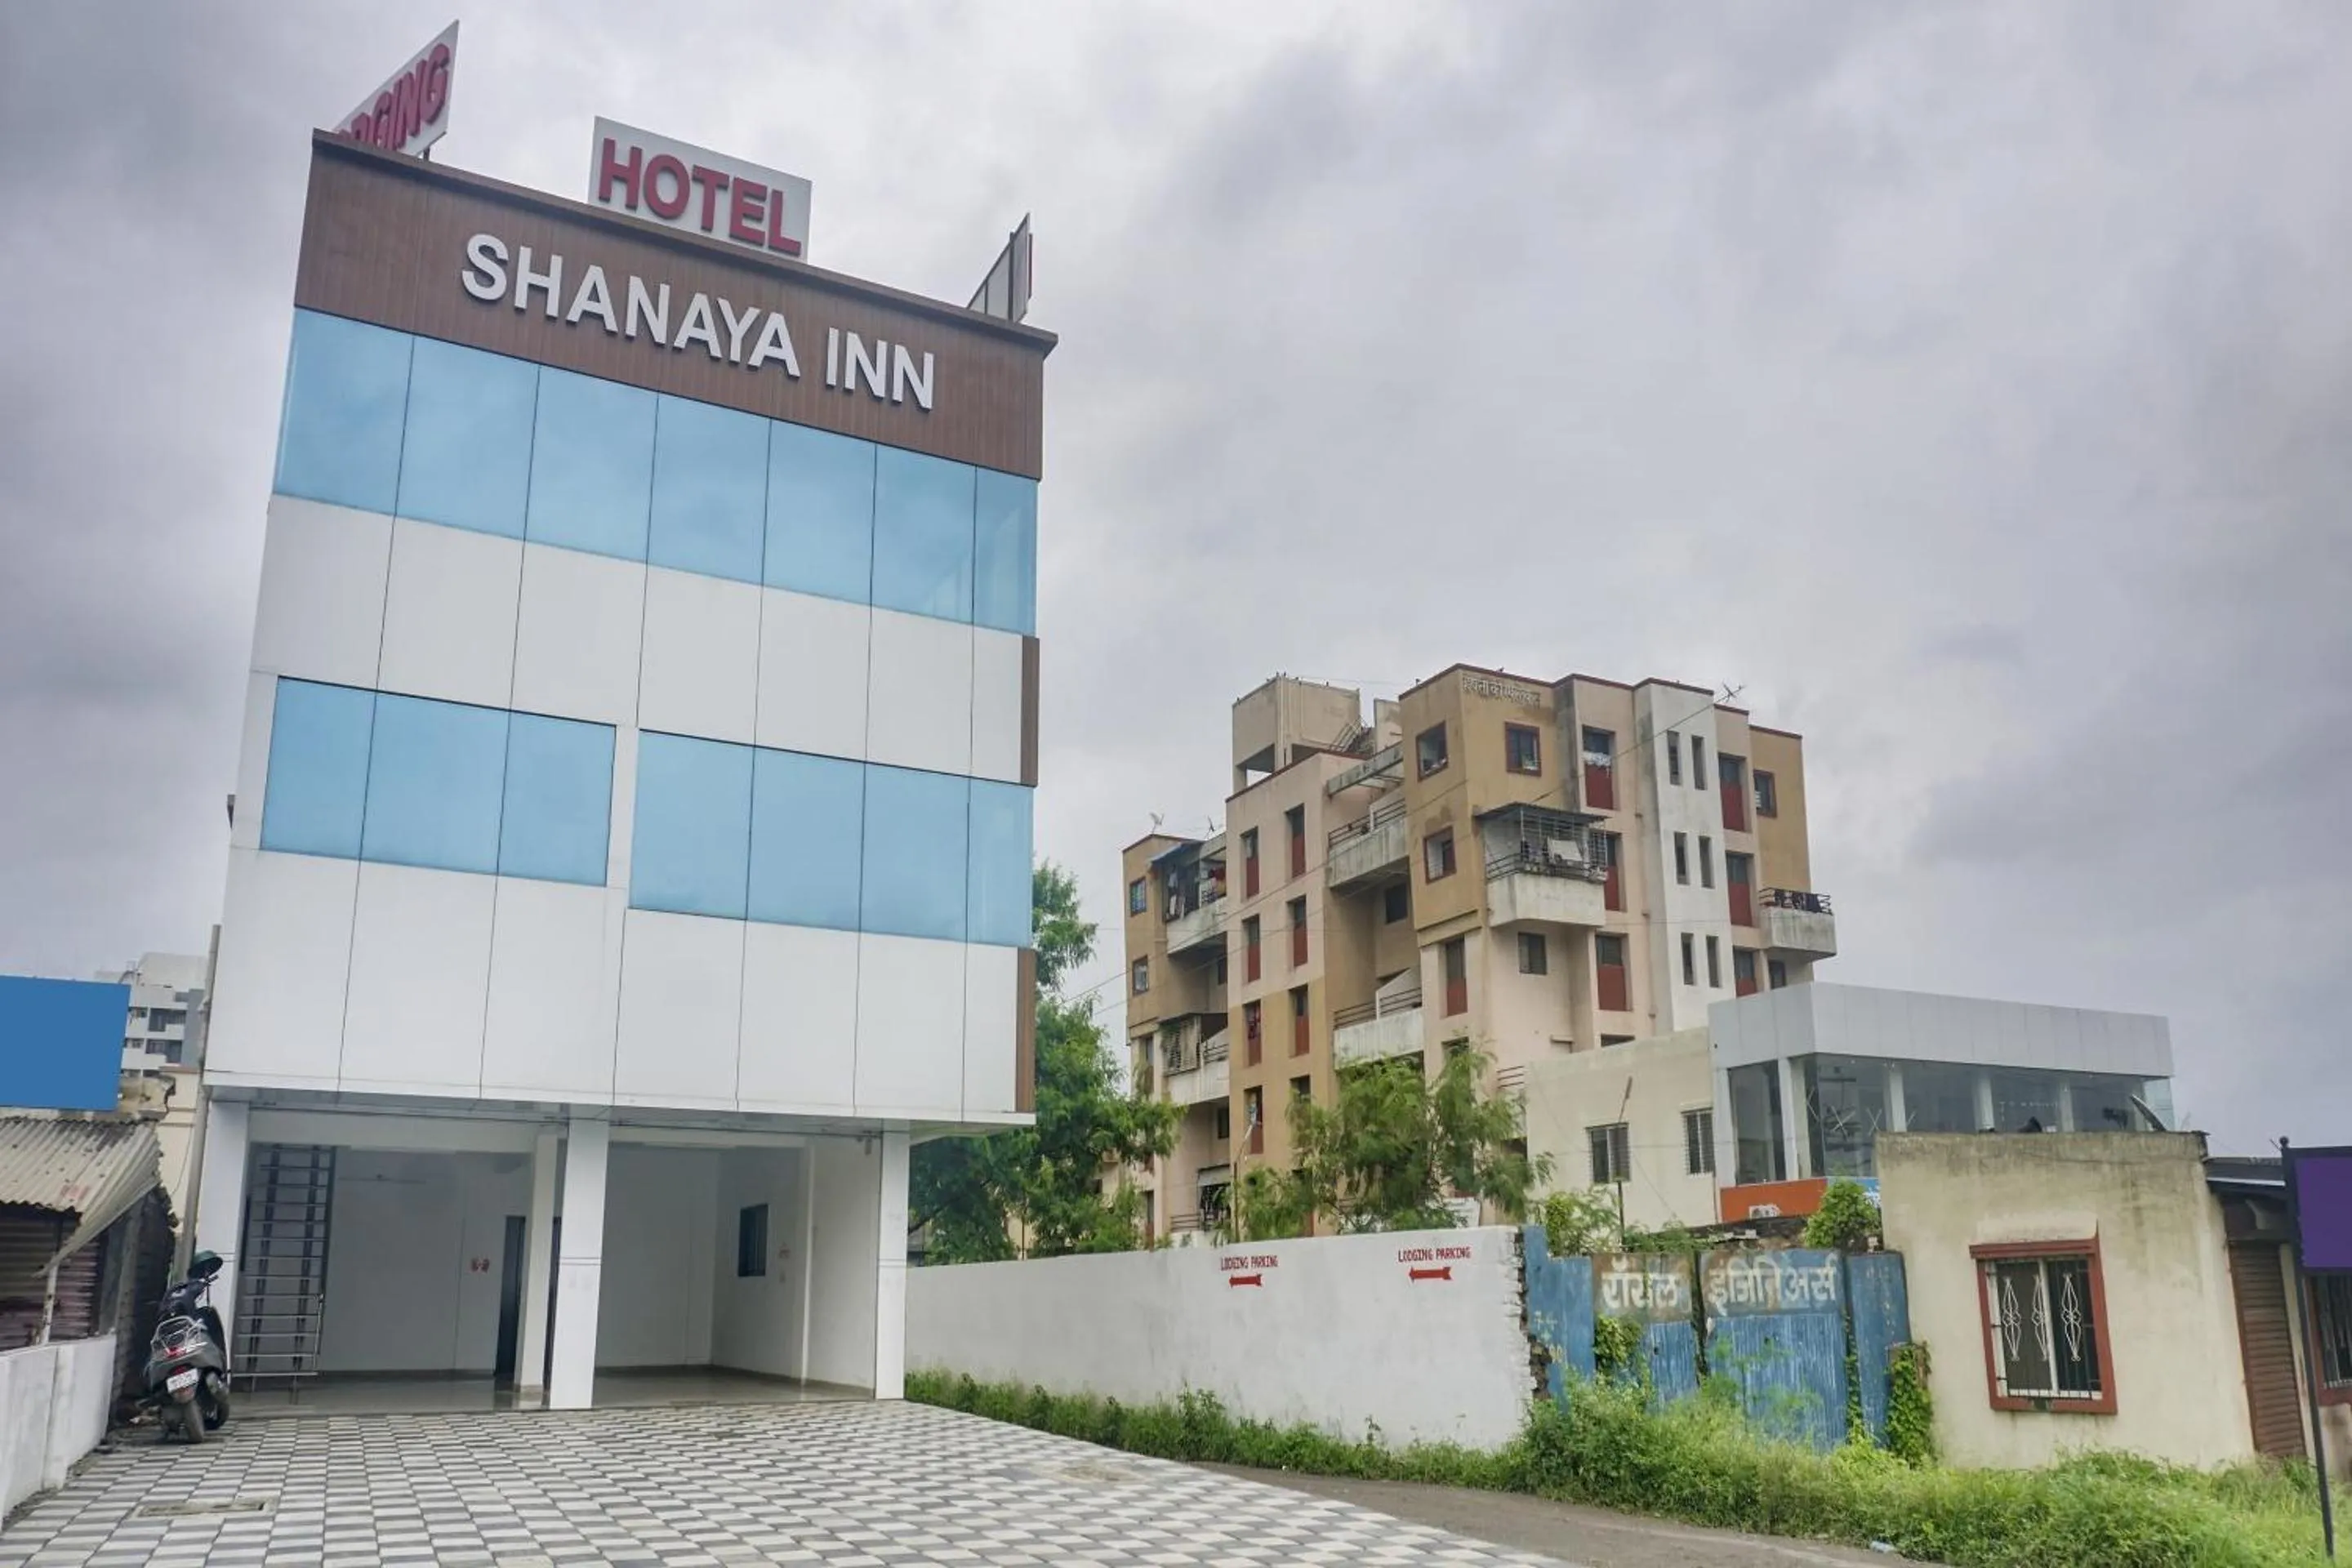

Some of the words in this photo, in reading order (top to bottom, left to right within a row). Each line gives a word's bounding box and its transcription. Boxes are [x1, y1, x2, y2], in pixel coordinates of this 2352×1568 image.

[599, 137, 802, 256] HOTEL
[461, 233, 801, 377] SHANAYA
[825, 327, 934, 411] INN
[1220, 1255, 1249, 1271] LODGING
[1250, 1254, 1279, 1267] PARKING
[1398, 1247, 1433, 1263] LODGING
[1436, 1245, 1472, 1259] PARKING
